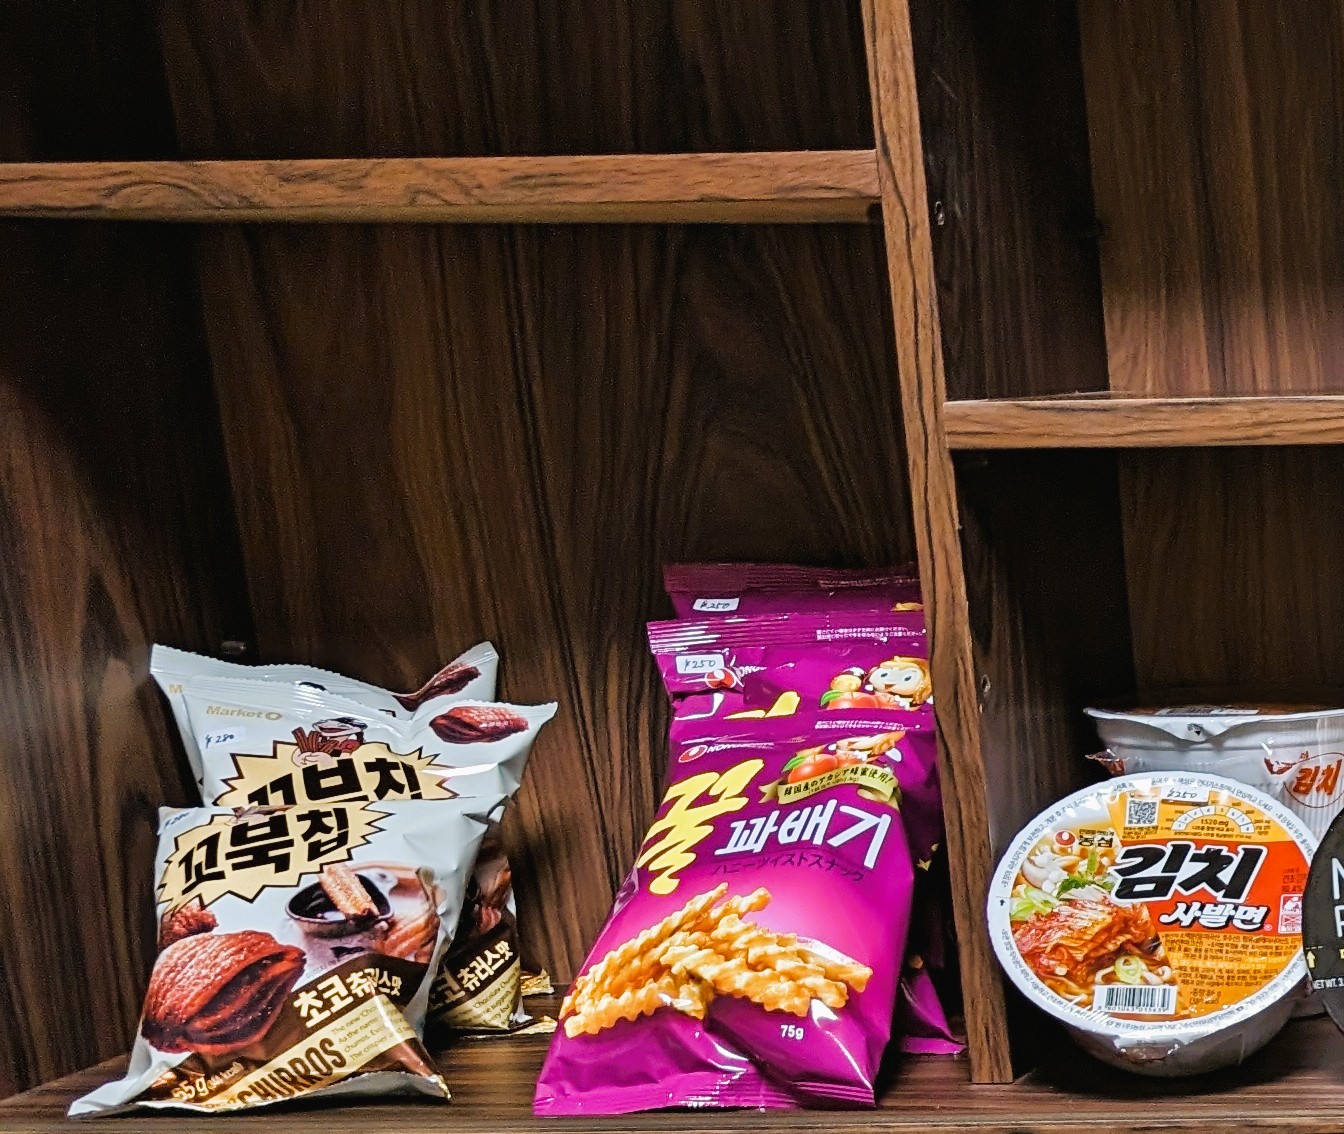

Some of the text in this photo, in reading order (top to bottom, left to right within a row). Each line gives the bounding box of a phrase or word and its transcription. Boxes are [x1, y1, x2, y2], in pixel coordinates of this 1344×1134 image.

[206, 705, 262, 719] Market
[1293, 759, 1343, 796] 김치
[178, 807, 350, 896] 꼬북칩
[637, 758, 764, 895] 꿀
[714, 799, 891, 869] 꽈배기
[1112, 840, 1267, 903] 김치
[1159, 901, 1267, 930] 사발면
[780, 1023, 804, 1040] 75g
